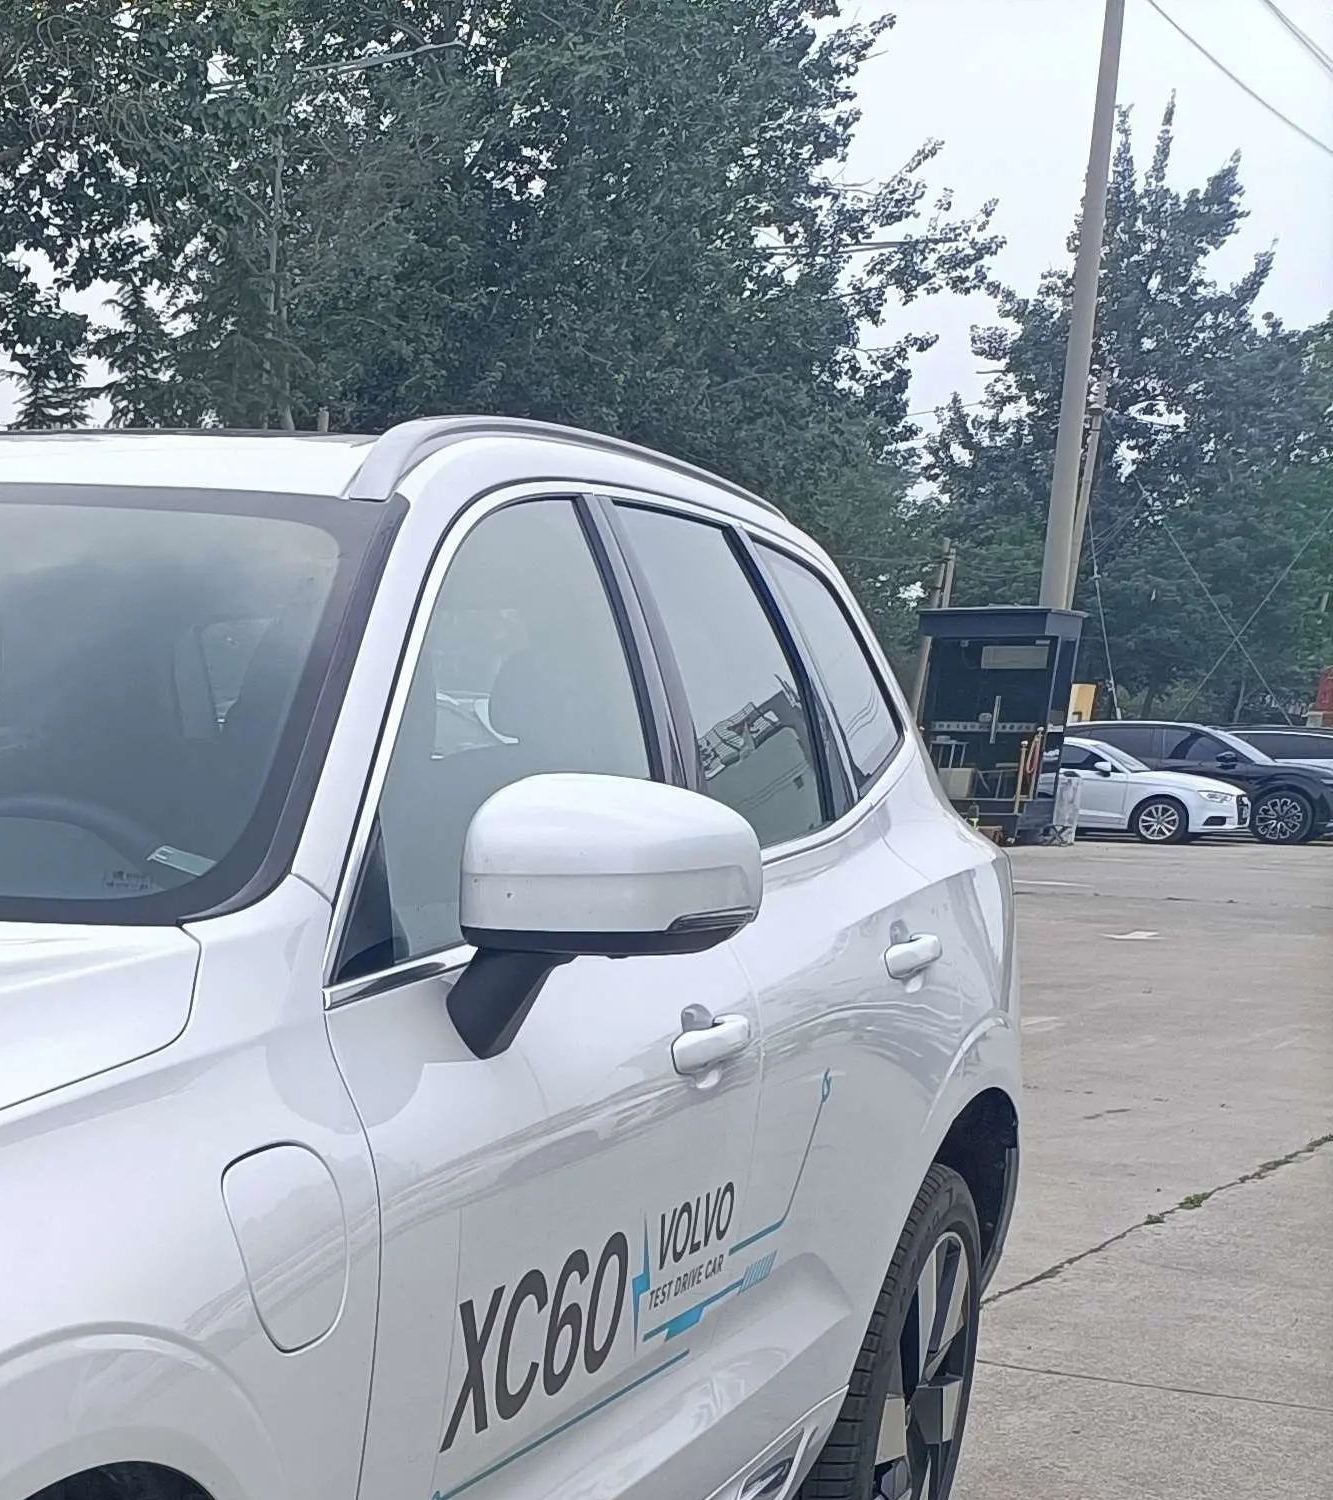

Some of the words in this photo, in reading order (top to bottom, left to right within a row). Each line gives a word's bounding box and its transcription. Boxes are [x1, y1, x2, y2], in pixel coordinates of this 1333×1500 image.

[658, 1181, 735, 1271] VOLVO
[648, 1280, 673, 1311] TEST
[674, 1264, 704, 1297] DRIVE
[705, 1254, 724, 1279] CAR
[439, 1231, 629, 1454] XC60
